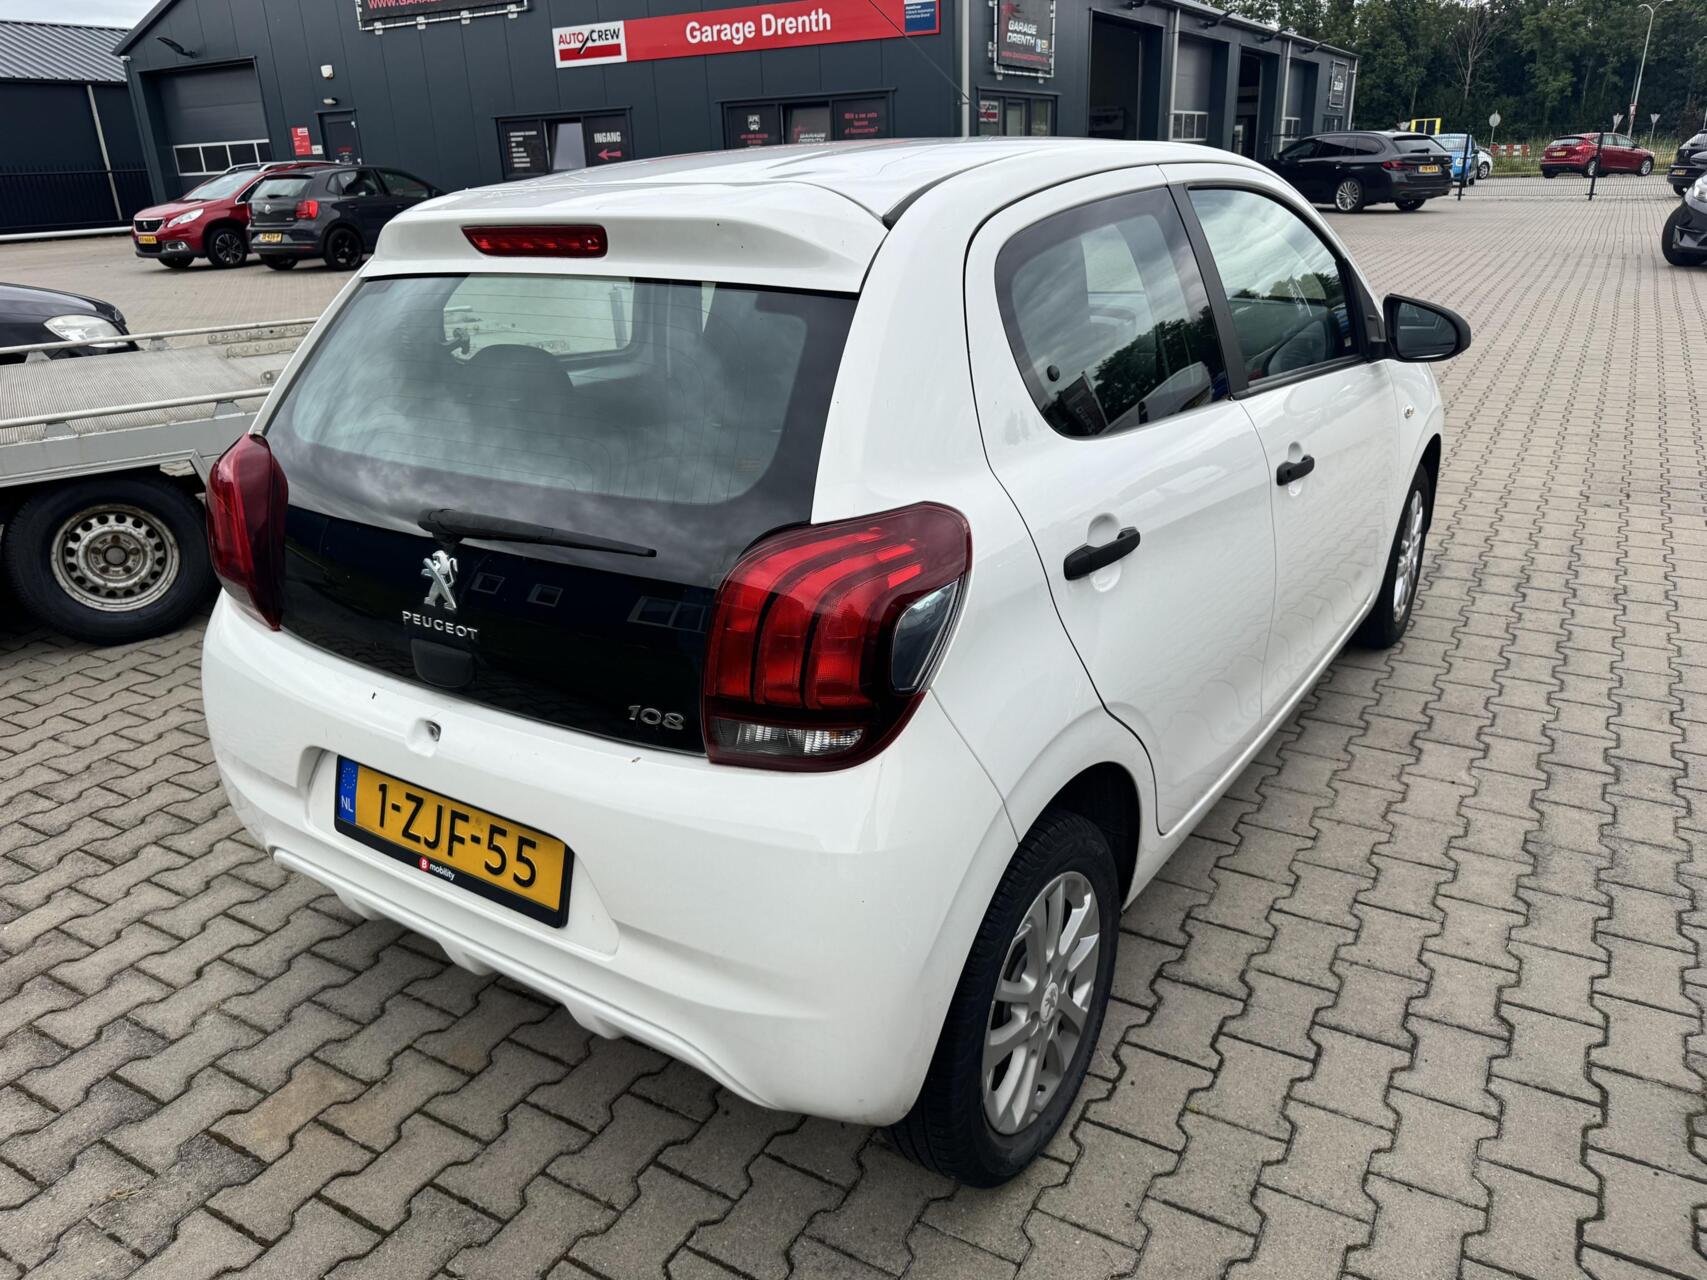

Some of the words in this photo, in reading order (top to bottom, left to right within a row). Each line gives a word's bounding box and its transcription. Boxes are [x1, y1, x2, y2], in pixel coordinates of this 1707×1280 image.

[685, 21, 755, 45] Garage
[761, 8, 831, 37] Drenth
[1008, 20, 1037, 35] GARAGE
[558, 32, 584, 45] AUTO
[590, 28, 620, 42] CREW
[1006, 32, 1036, 47] DRENTH
[594, 131, 621, 143] INGANG
[401, 611, 478, 640] PEUGEOT
[628, 705, 684, 730] 108
[341, 796, 353, 813] NL
[378, 783, 537, 889] 1-ZJF-55
[429, 863, 457, 881] mobility
